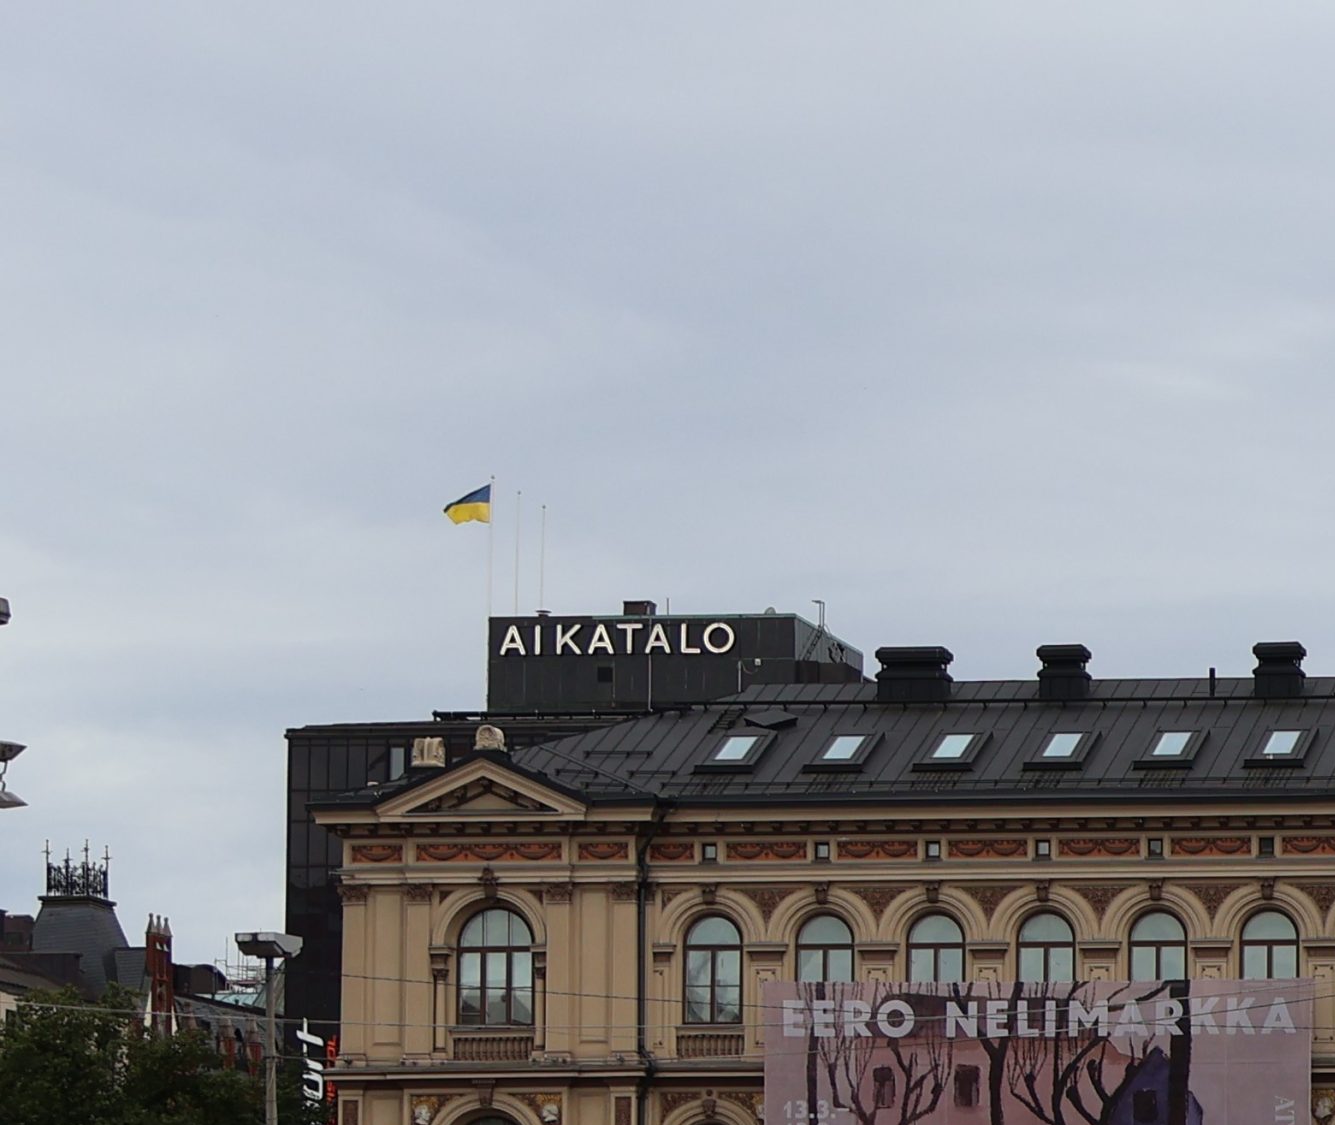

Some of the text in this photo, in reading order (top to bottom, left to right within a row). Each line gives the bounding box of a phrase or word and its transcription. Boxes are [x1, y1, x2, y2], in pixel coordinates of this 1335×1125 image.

[499, 622, 736, 656] AIKATALO
[783, 997, 1296, 1038] EERO NELIMARKKA
